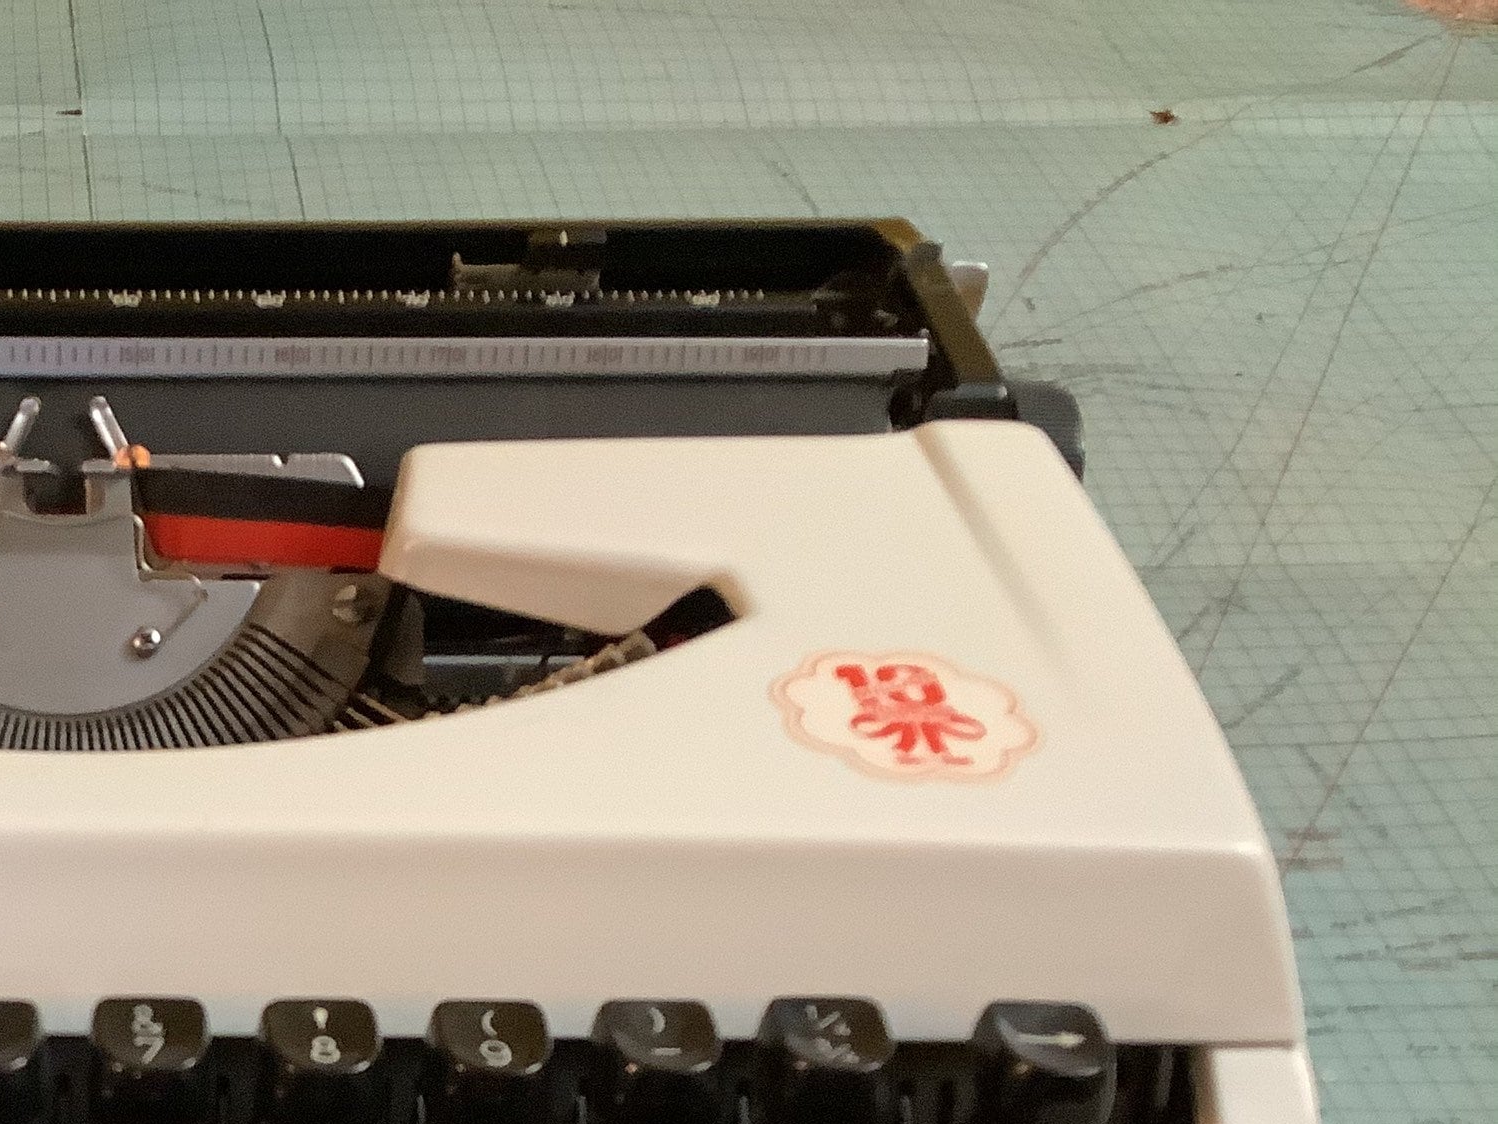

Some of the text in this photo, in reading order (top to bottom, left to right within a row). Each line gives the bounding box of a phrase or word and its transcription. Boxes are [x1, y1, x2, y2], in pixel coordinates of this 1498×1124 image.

[134, 1033, 165, 1064] 7
[309, 1035, 341, 1065] 8
[478, 1039, 513, 1068] 9
